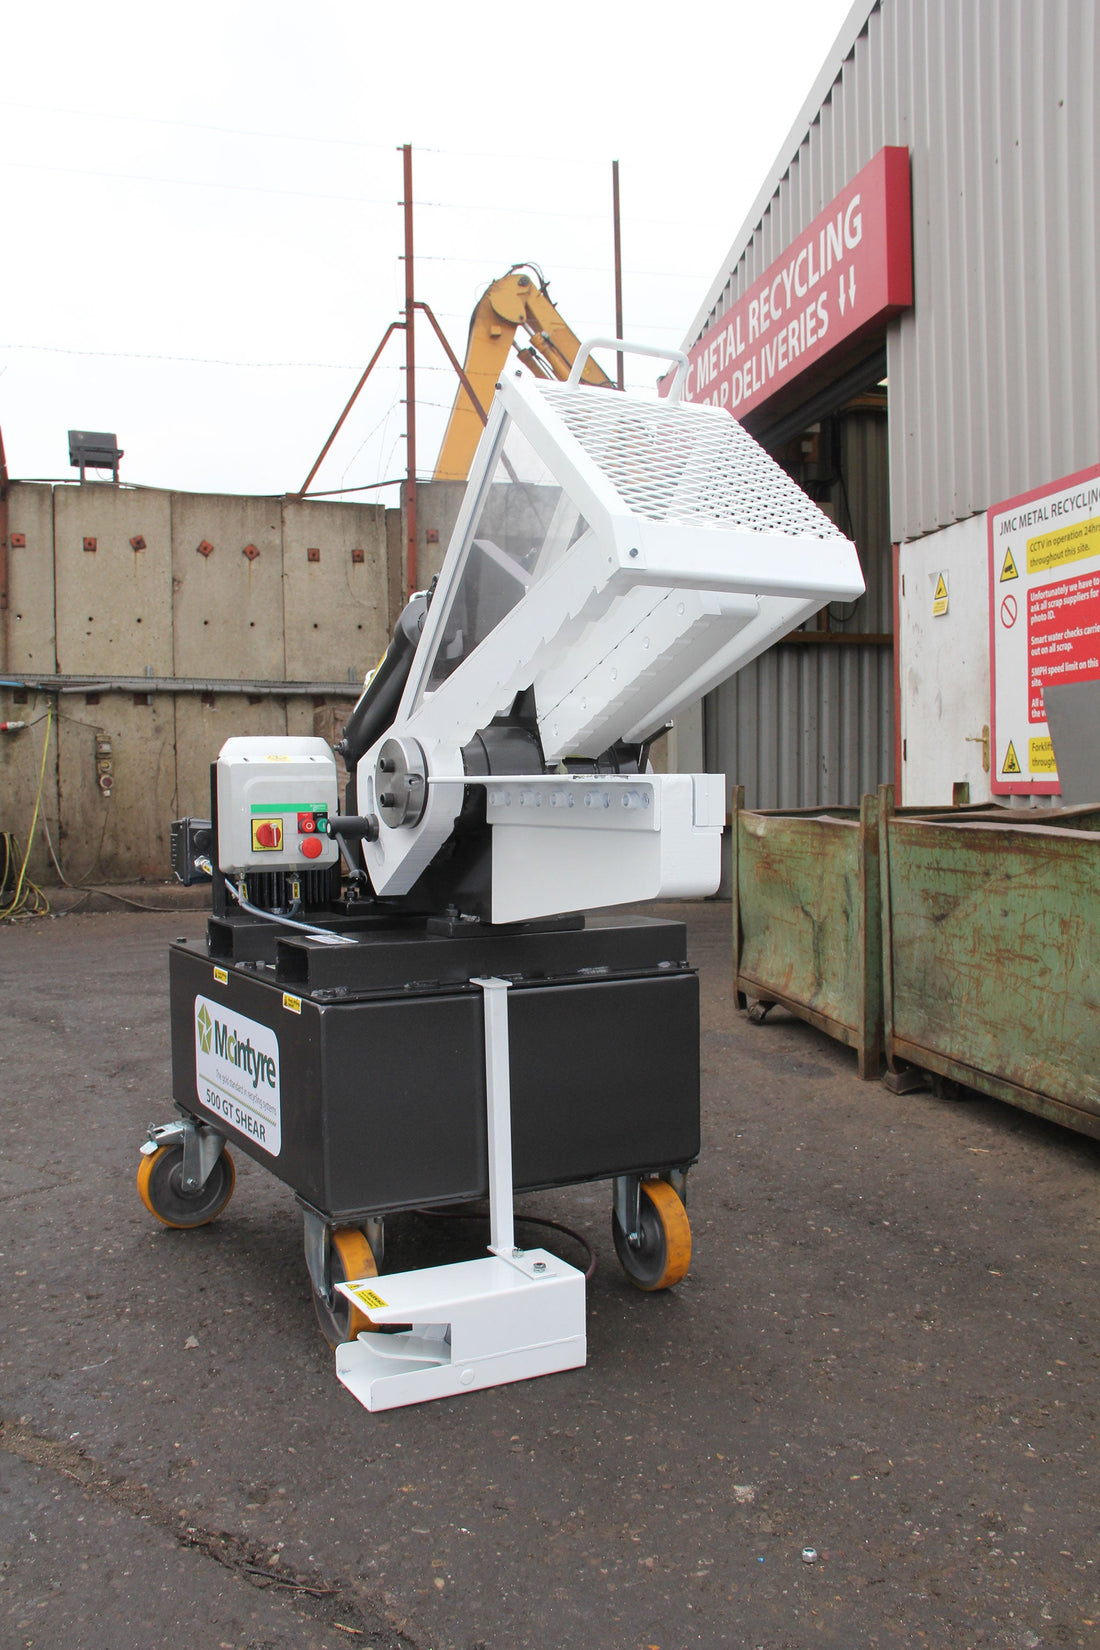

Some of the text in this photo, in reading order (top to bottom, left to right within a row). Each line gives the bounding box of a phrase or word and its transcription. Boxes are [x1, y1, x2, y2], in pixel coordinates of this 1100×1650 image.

[697, 193, 862, 394] METAL RECYCLING
[732, 290, 829, 409] DELIVERIES
[1000, 486, 1100, 536] JMC METAL RECYCLIN
[1029, 539, 1045, 553] CCTV
[1046, 537, 1052, 547] in
[1053, 529, 1083, 547] operation
[1030, 542, 1090, 567] throughout this site.
[1030, 577, 1100, 602] Unfortunately we have to
[1030, 602, 1040, 613] ask
[1048, 598, 1062, 609] scrap
[1063, 590, 1089, 606] suppliers
[1090, 588, 1099, 599] for
[1030, 613, 1047, 626] photo
[1031, 634, 1047, 646] Smart
[1048, 631, 1063, 643] water
[1064, 627, 1083, 639] checks
[1031, 647, 1040, 657] out
[1041, 646, 1048, 655] on
[1057, 641, 1073, 653] scrap.
[1048, 663, 1065, 676] speed
[1065, 661, 1078, 672] limit
[1079, 660, 1087, 670] on
[1087, 657, 1099, 669] this
[1031, 678, 1043, 688] site.
[1031, 698, 1039, 707] All
[1031, 708, 1041, 718] the
[206, 1088, 266, 1143] 500 GT SHEAR
